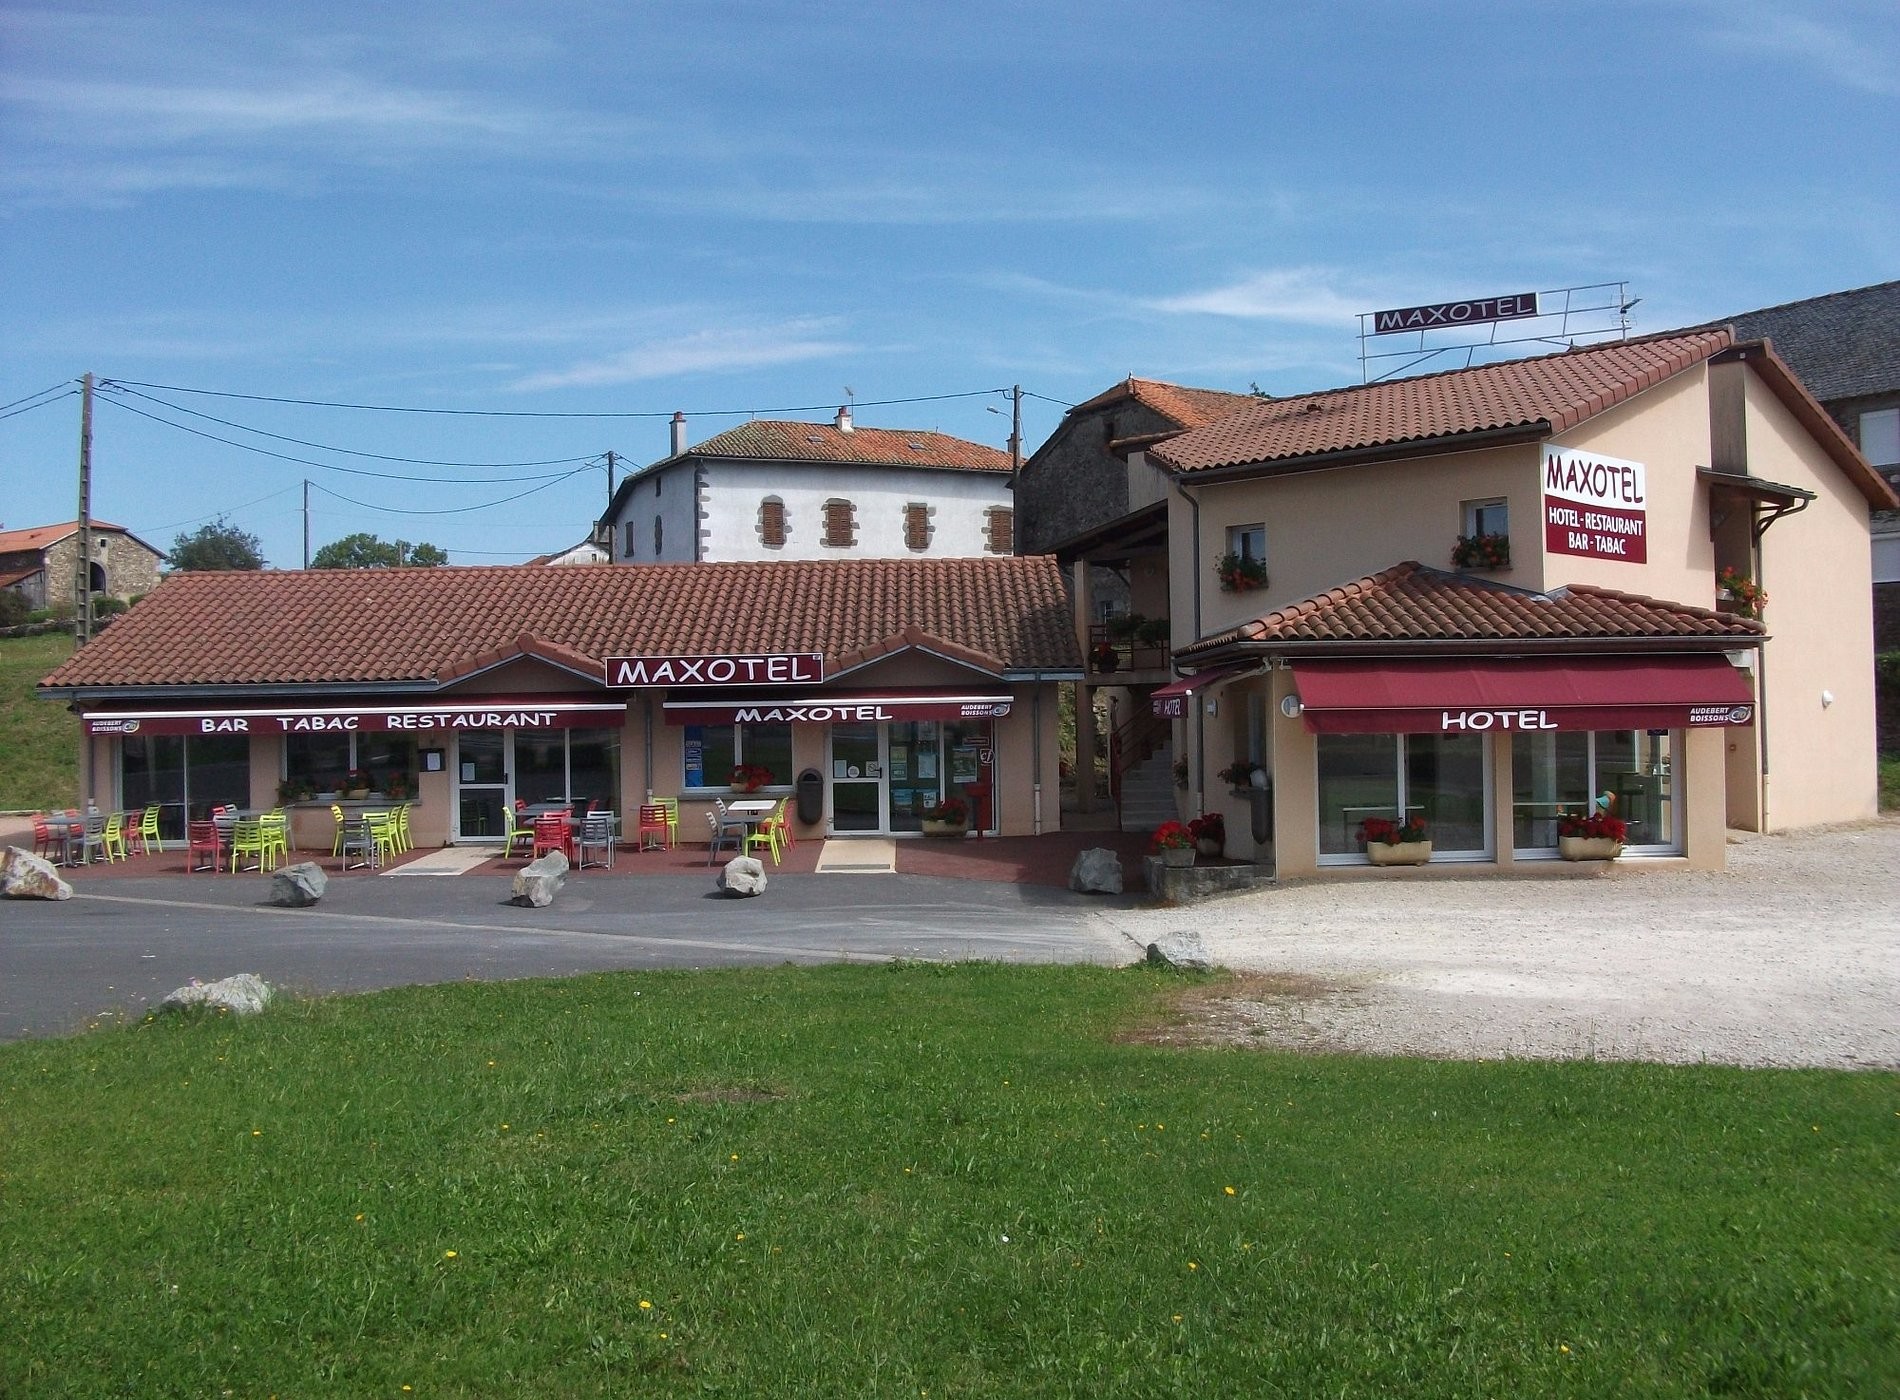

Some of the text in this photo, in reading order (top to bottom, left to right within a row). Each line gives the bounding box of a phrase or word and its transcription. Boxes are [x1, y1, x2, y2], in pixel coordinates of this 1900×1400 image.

[1379, 296, 1533, 330] MAXOTEL
[1547, 453, 1643, 504] MAXOTEL
[617, 656, 812, 684] MAXOTEL
[734, 706, 894, 722] MAXOTEL
[1442, 710, 1559, 730] HOTEL
[1690, 707, 1730, 715] AUDEBERT
[201, 712, 558, 733] BAR TABAC RESTAURANT
